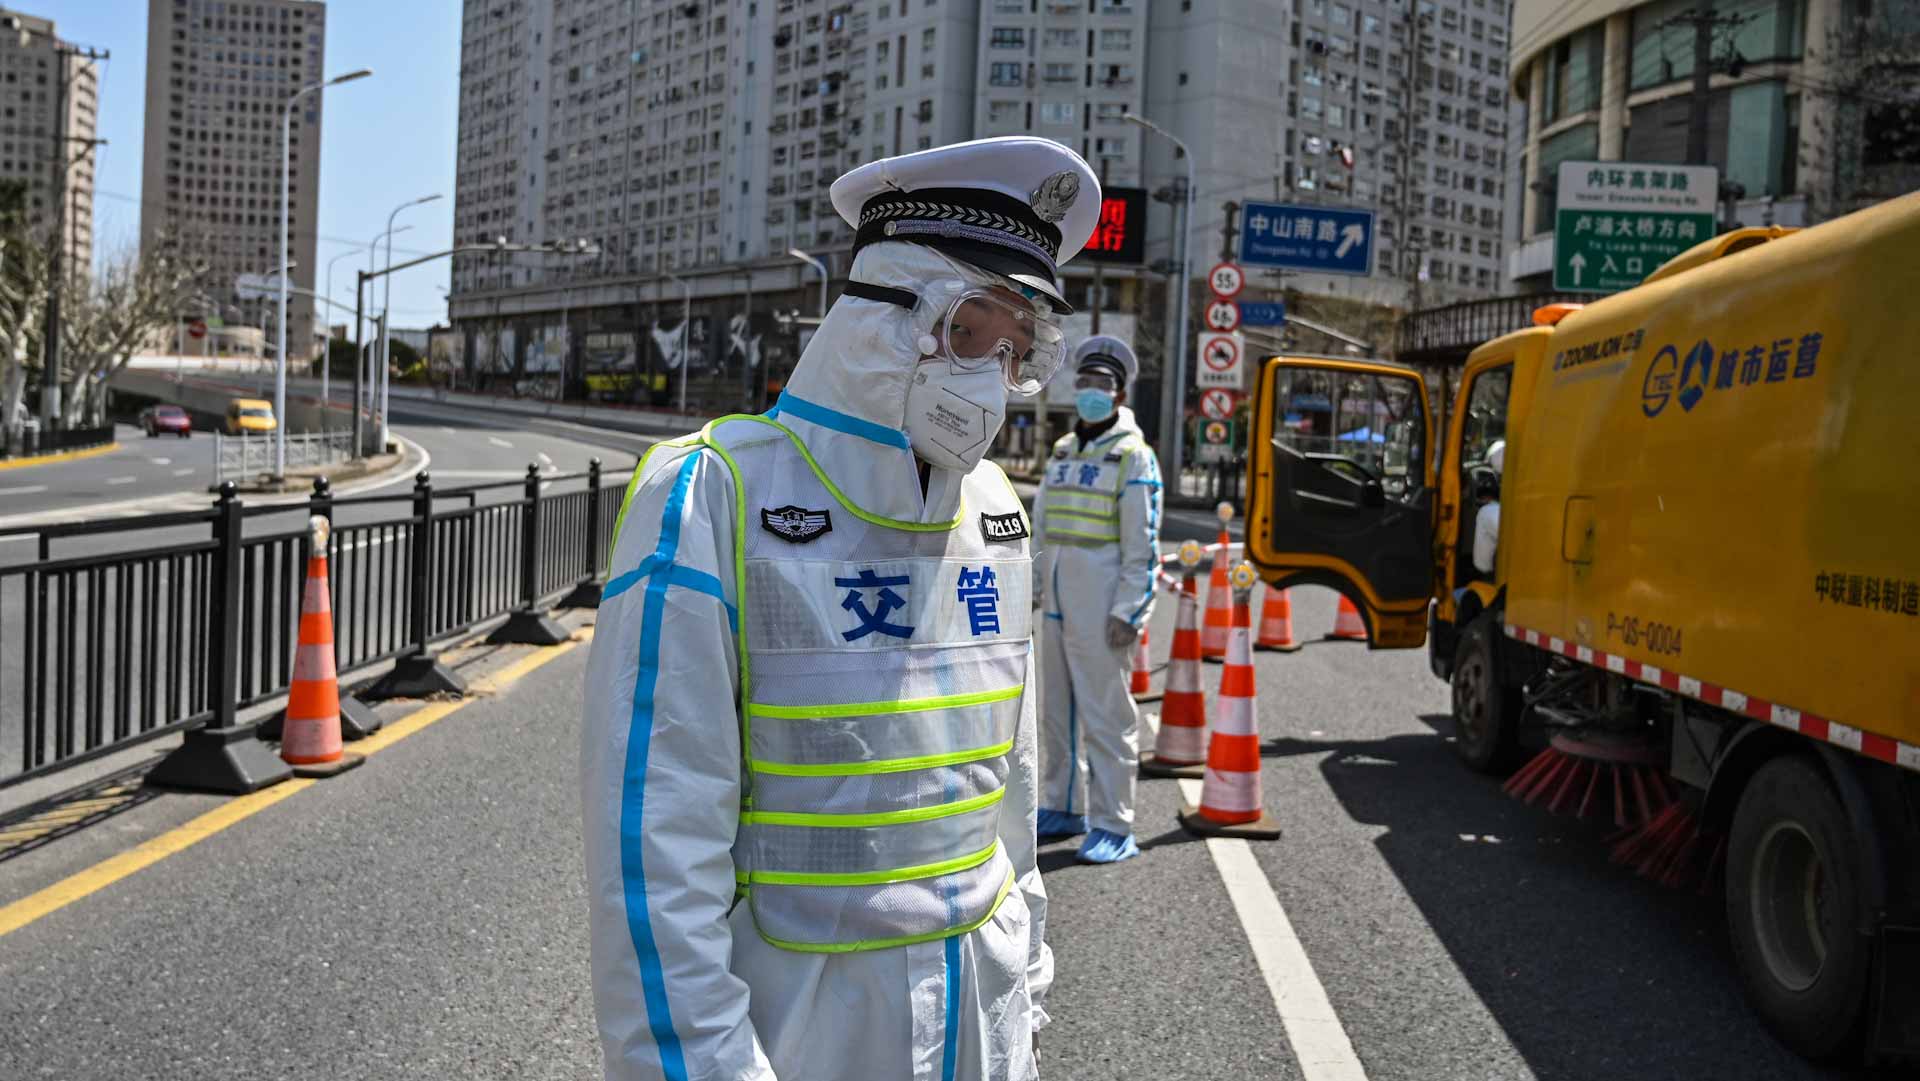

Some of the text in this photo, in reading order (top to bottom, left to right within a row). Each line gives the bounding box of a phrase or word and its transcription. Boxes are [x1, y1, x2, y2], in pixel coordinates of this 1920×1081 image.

[1587, 169, 1688, 191] 内环高架路
[1250, 213, 1337, 242] 中山南路
[1575, 215, 1696, 239] 卢浦大桥方向
[1601, 255, 1643, 274] 入口
[1562, 336, 1622, 369] ZOOMLION
[1715, 331, 1824, 389] 城市运营
[834, 566, 1001, 642] 交管
[1815, 569, 1920, 617] 中联重科制造
